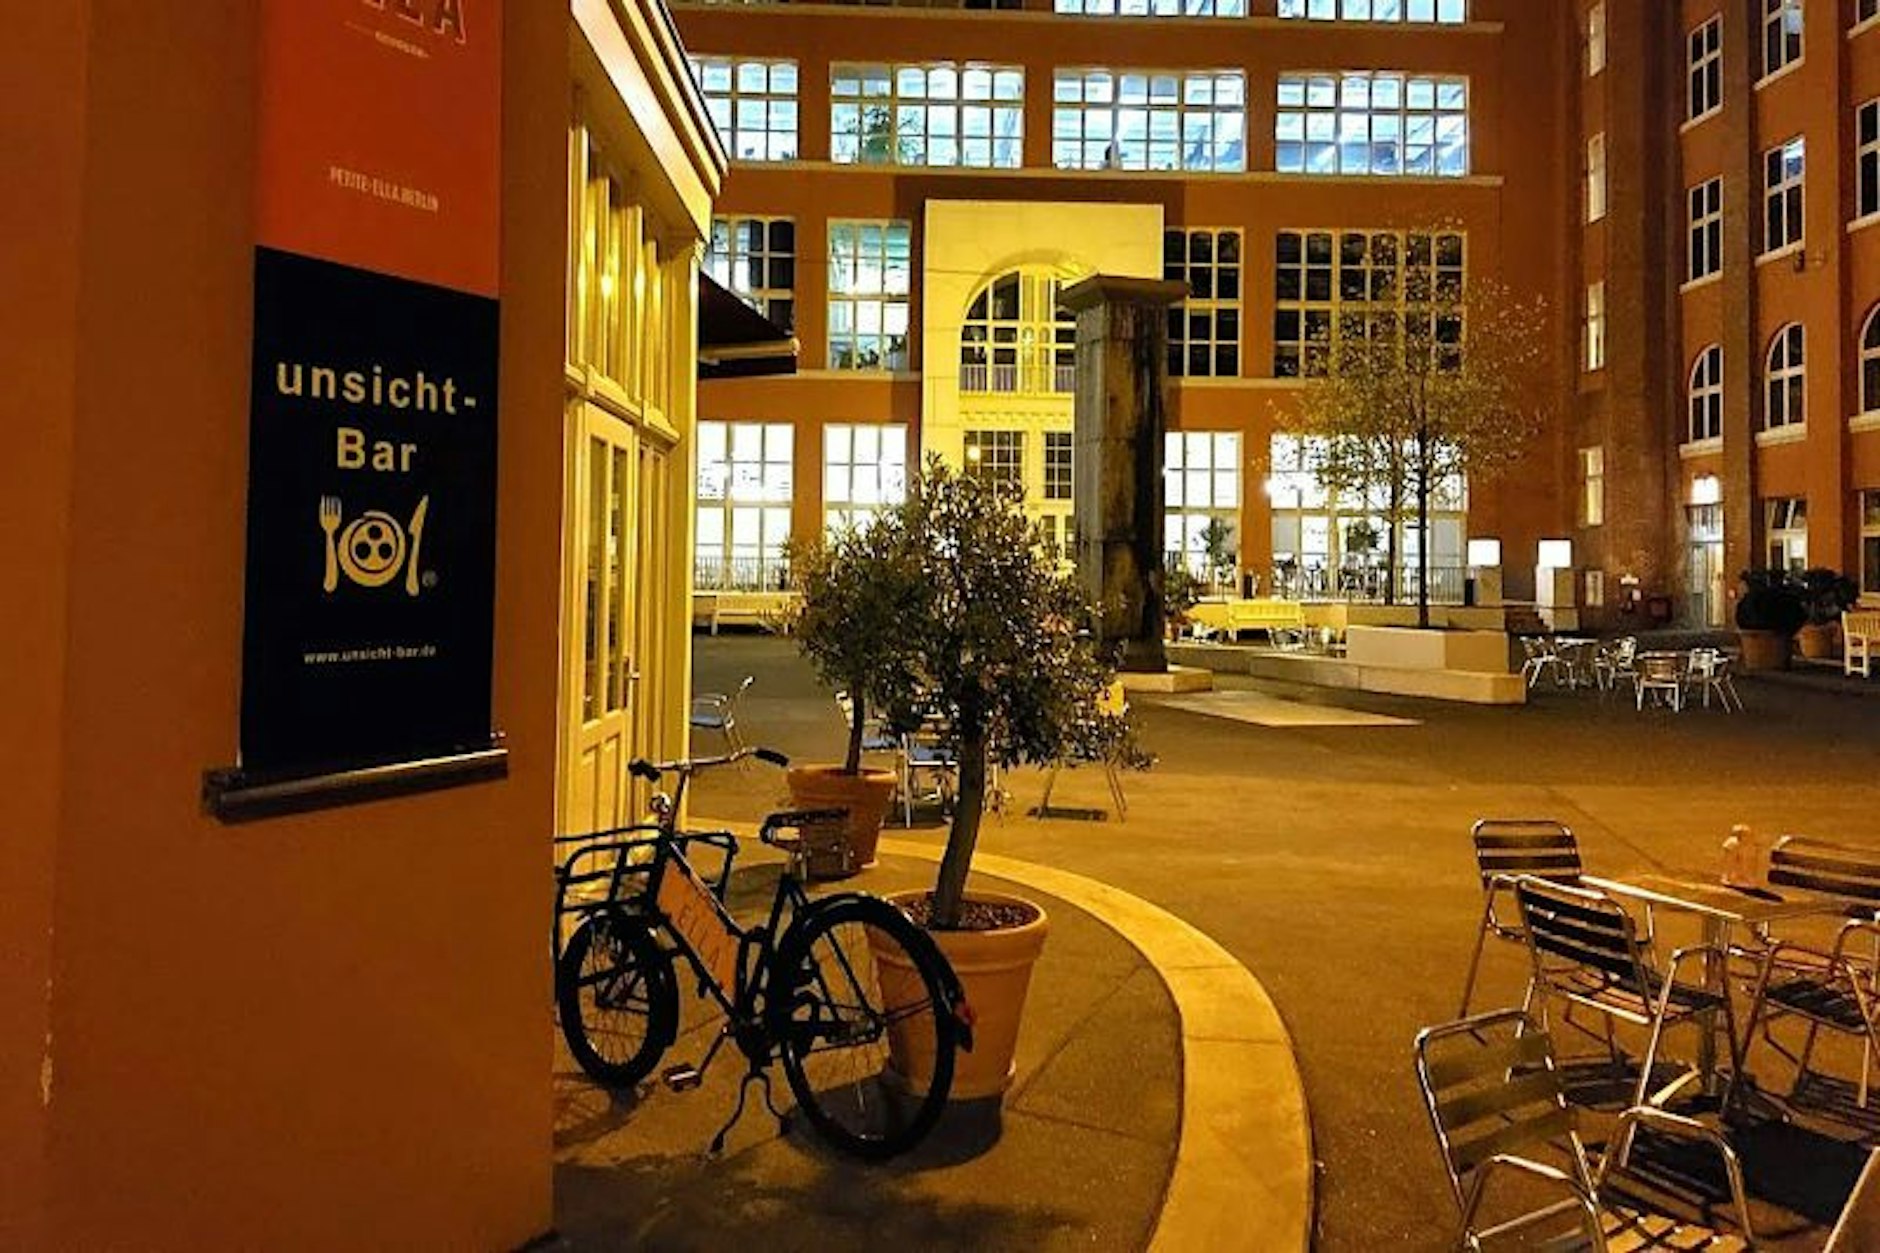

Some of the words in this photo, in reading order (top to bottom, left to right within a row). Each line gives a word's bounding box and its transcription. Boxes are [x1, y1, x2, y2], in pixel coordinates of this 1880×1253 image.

[277, 361, 477, 415] unsicht-
[336, 427, 417, 472] Bar
[304, 644, 436, 664] www.unsicht-bar.de
